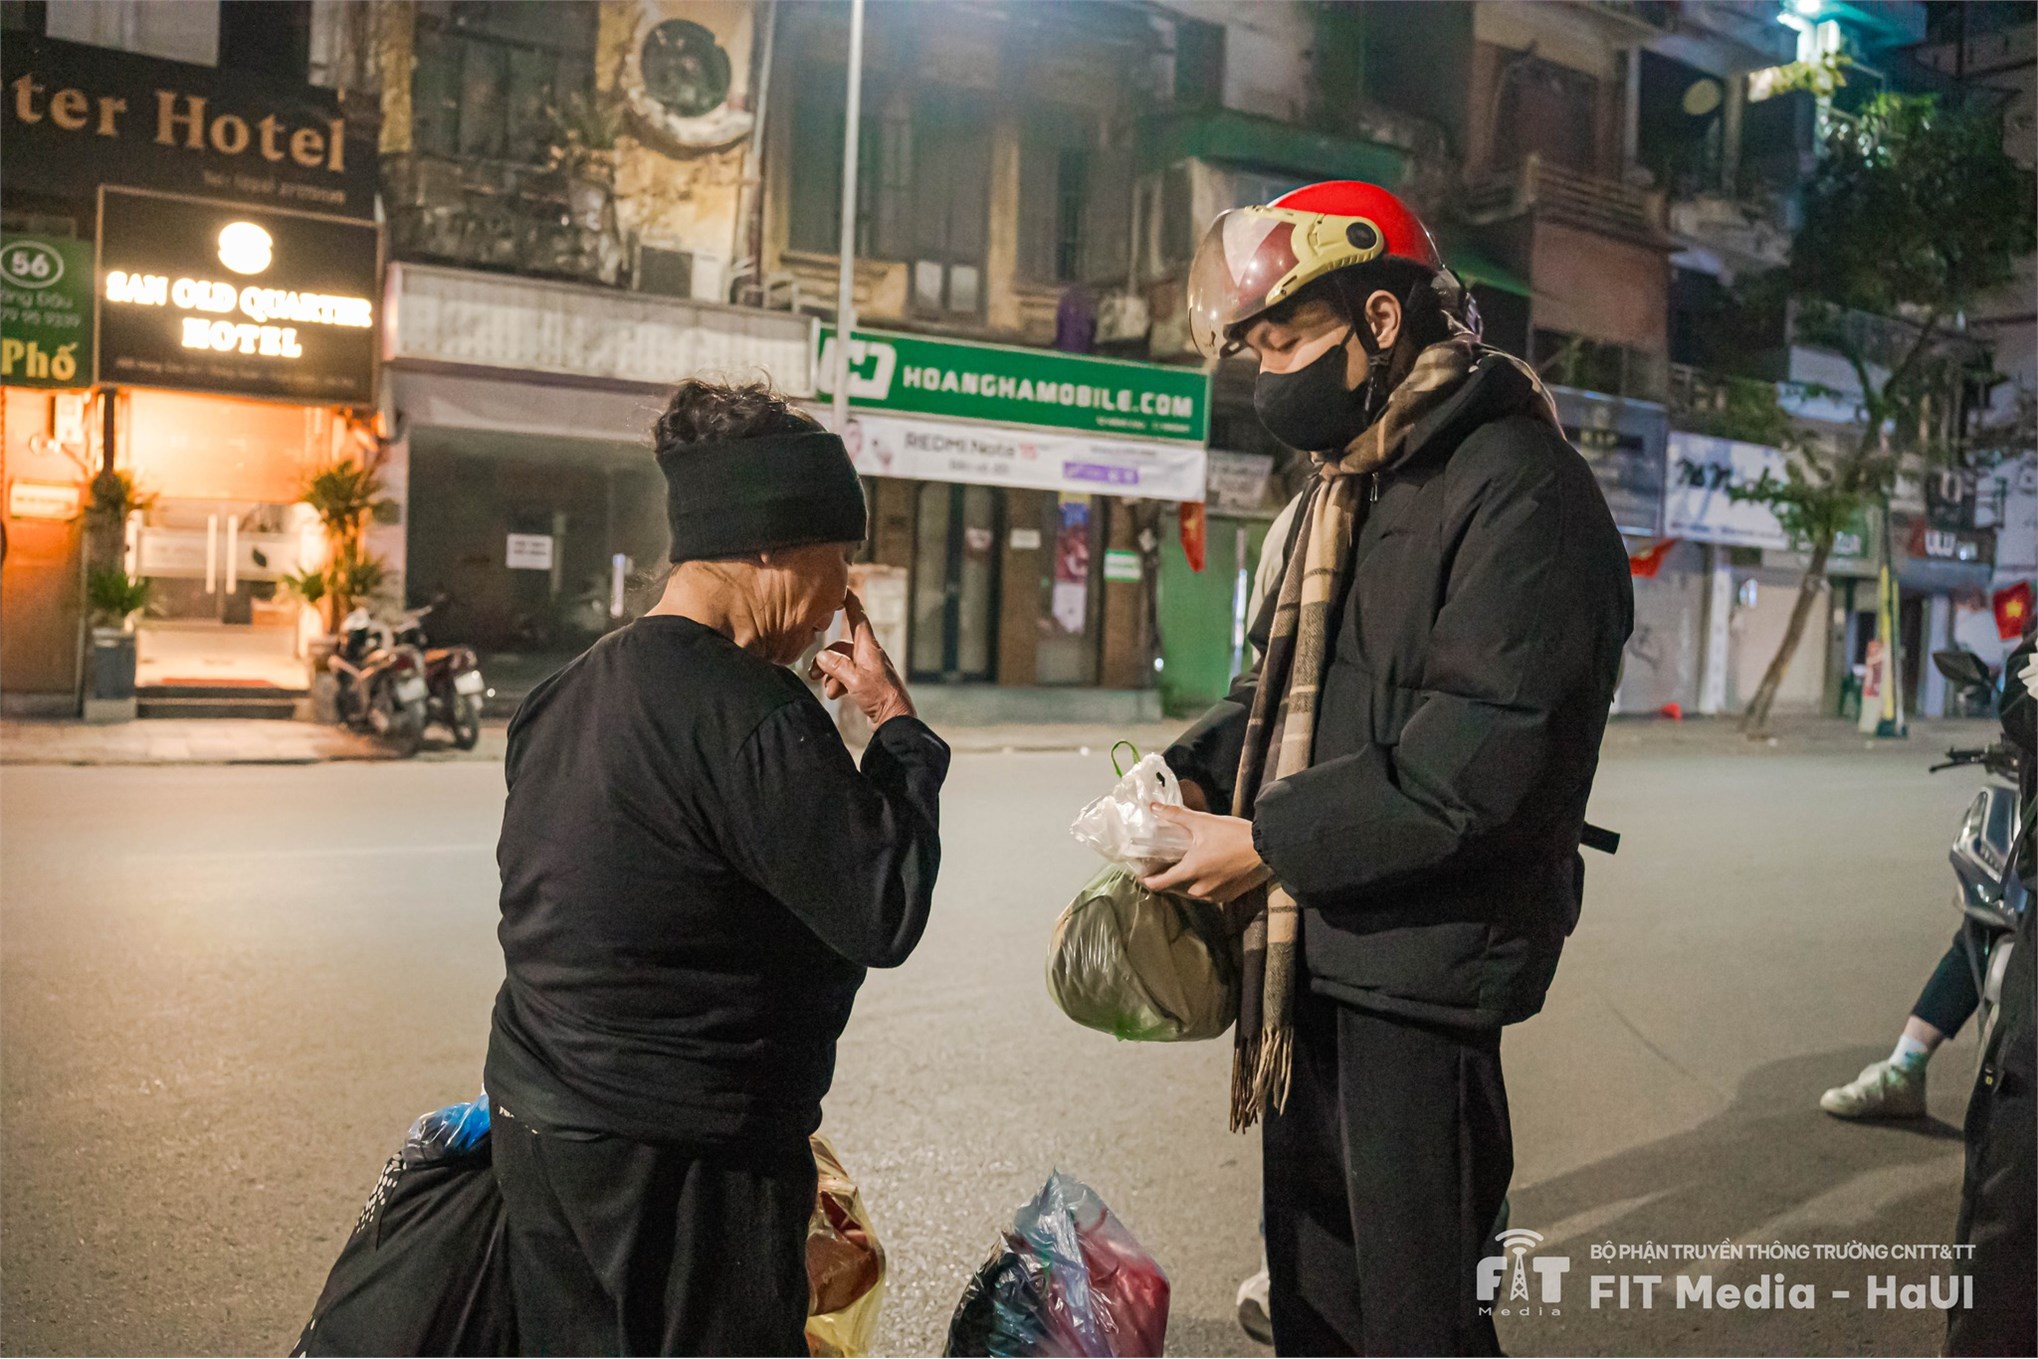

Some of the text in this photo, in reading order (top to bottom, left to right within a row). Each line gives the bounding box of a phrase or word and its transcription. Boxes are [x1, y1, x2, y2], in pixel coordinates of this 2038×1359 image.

[154, 87, 345, 173] Hotel
[12, 250, 50, 278] 56
[106, 271, 168, 306] SAN
[172, 278, 237, 313] OLD
[239, 286, 373, 328] QUARTER
[181, 317, 302, 358] HOTEL
[1, 338, 78, 381] Phố
[903, 365, 1193, 418] HOANGHAMOBILE.COM
[905, 432, 966, 453] REDMI
[970, 438, 1016, 457] Note
